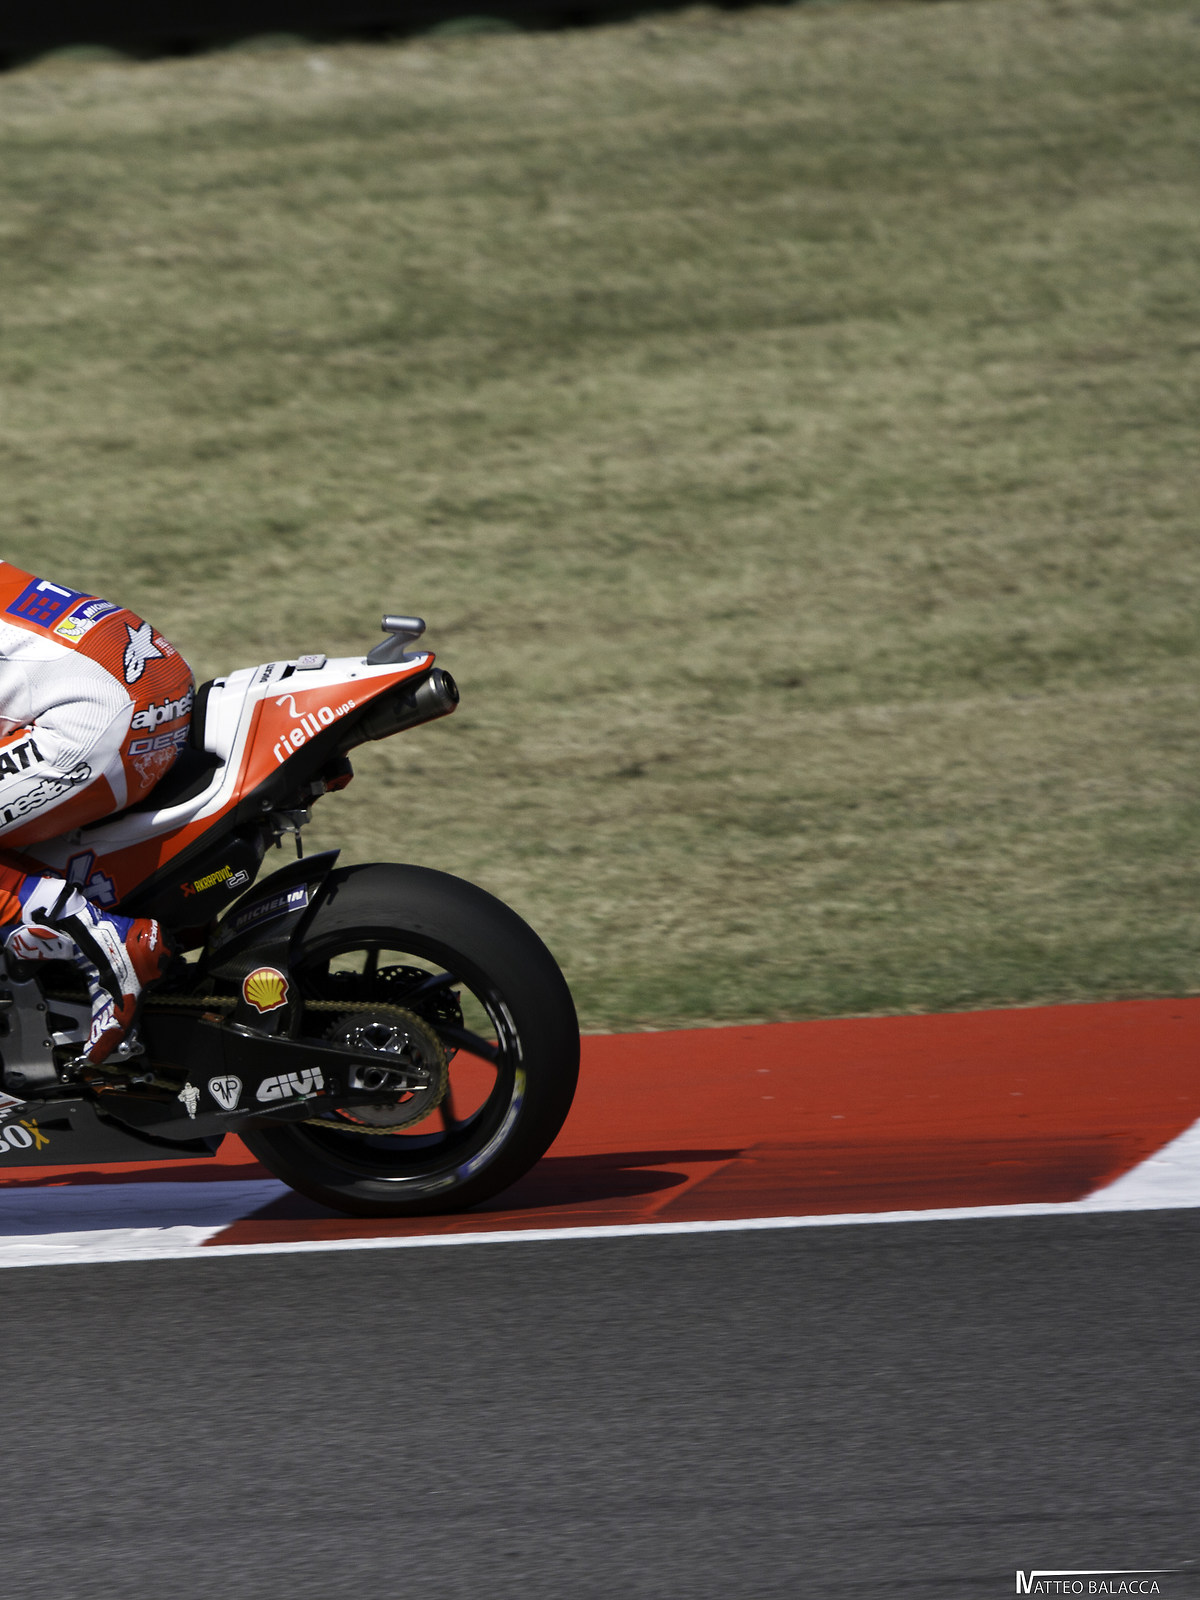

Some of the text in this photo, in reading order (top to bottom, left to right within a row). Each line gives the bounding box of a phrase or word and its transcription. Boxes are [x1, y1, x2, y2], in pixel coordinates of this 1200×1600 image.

[130, 686, 194, 733] alpines
[273, 699, 356, 763] riello ups
[236, 890, 304, 926] MICHELIN
[256, 1066, 325, 1102] GIVI
